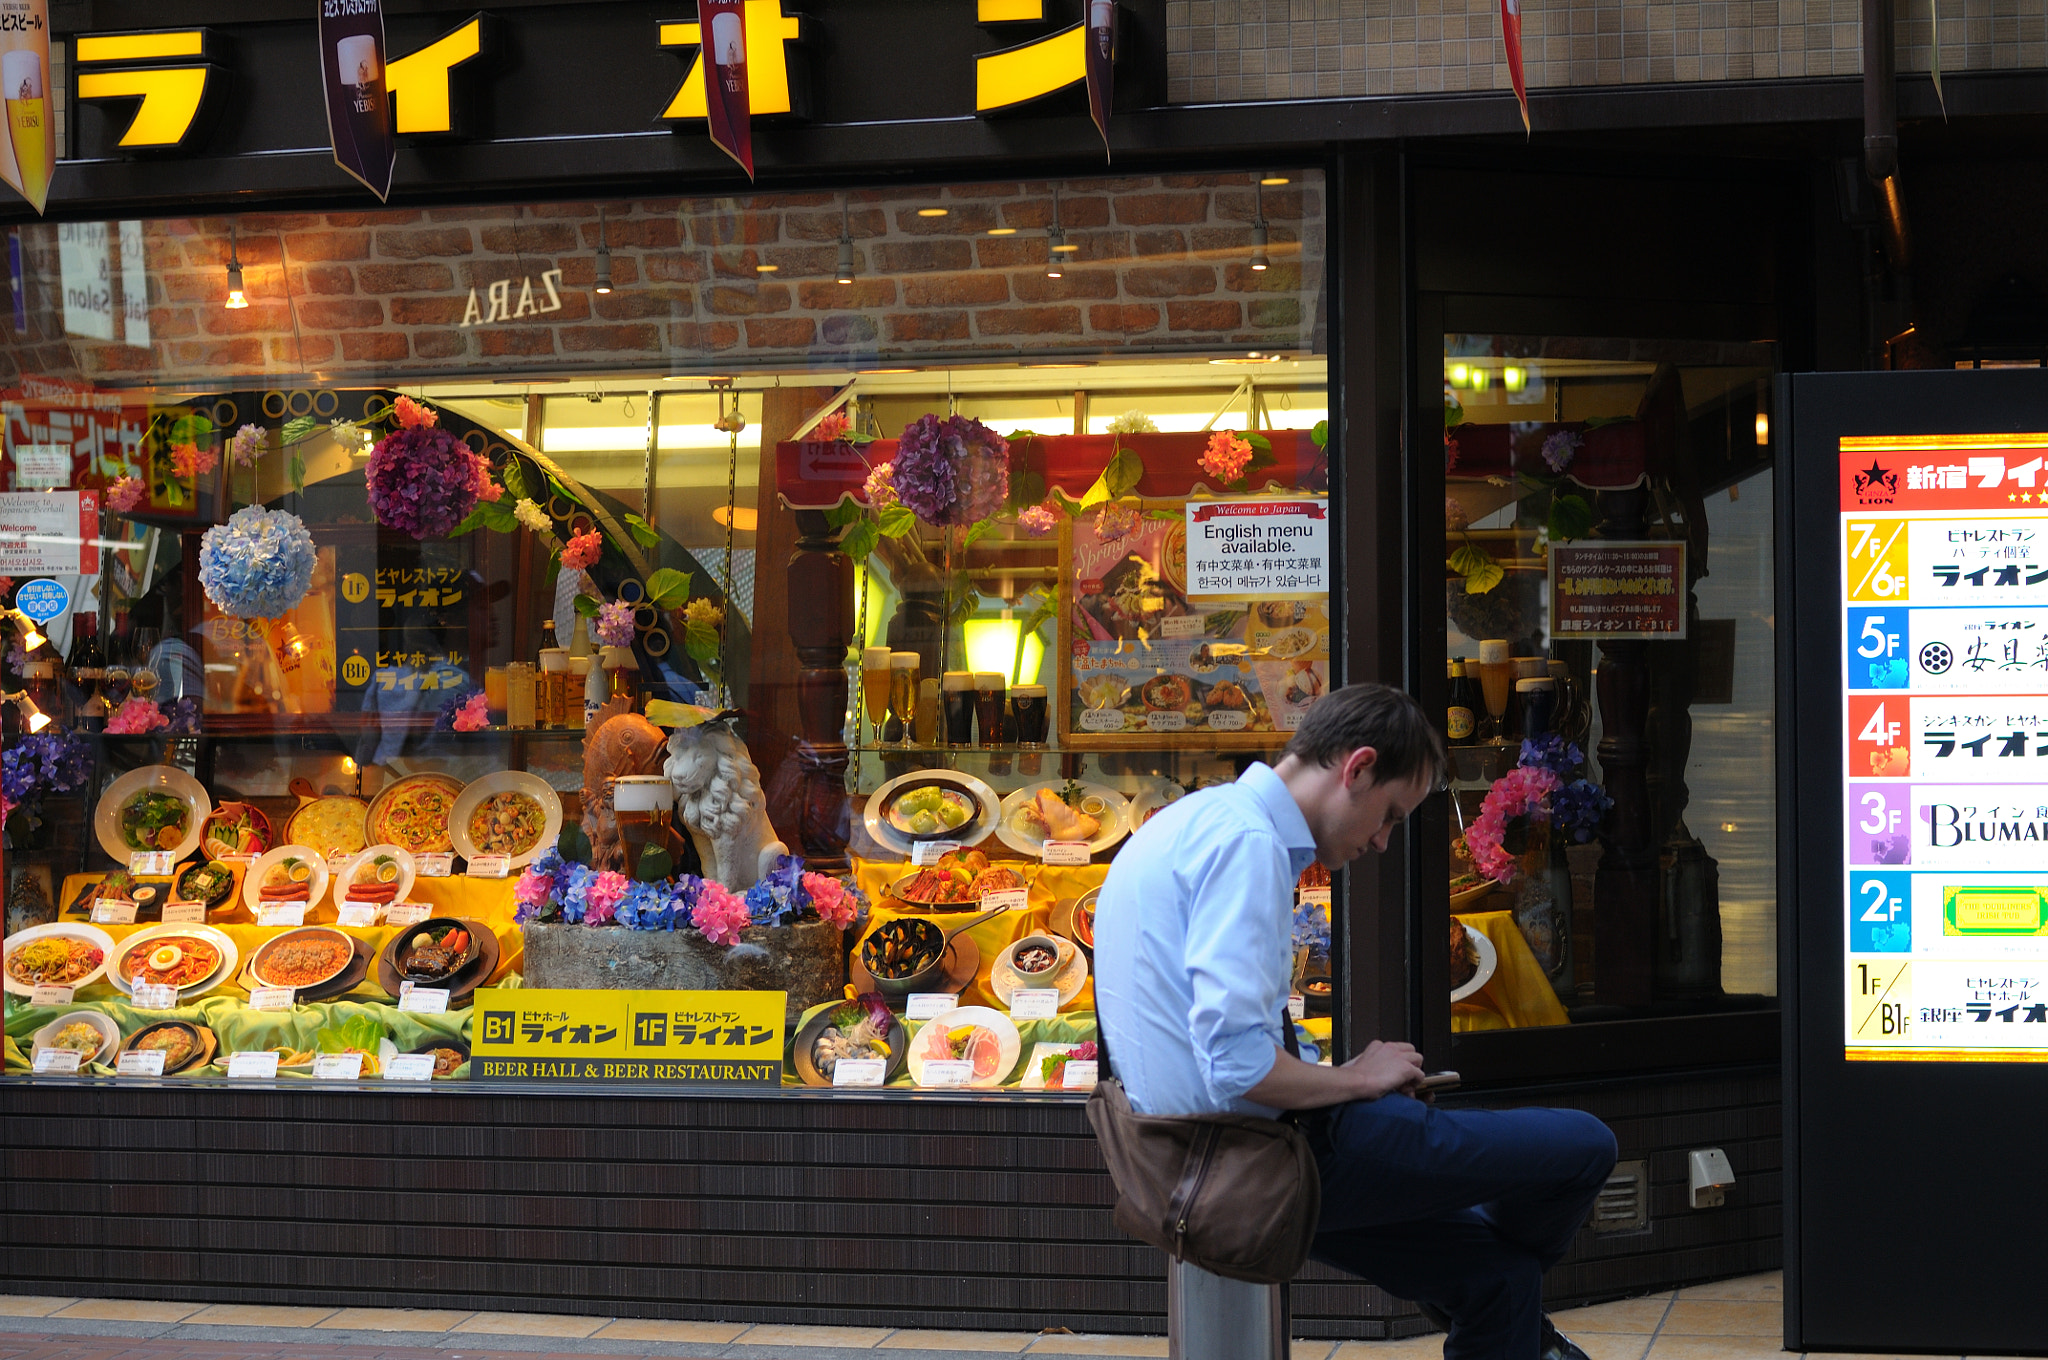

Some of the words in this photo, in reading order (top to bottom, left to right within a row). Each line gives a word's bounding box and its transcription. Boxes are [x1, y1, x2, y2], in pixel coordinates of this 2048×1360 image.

[0, 14, 42, 31] ビスビール
[1907, 456, 2048, 490] 新宿ライ
[1215, 504, 1256, 514] Welcome
[1259, 505, 1269, 513] to
[1271, 504, 1301, 515] Japan
[0, 524, 37, 532] Welcome
[1205, 524, 1262, 542] English
[1268, 525, 1313, 538] menu
[1221, 539, 1296, 553] available.
[375, 568, 462, 585] ビヤレストラン
[1198, 576, 1232, 589] 한국어
[1237, 575, 1271, 588] 메뉴가
[1275, 574, 1321, 587] 있습니다
[1933, 564, 2048, 587] ライオン
[375, 588, 462, 608] ライオン
[1857, 616, 1900, 658] 5F
[376, 651, 463, 668] ビヤホール
[376, 672, 463, 690] ライオン
[1857, 702, 1901, 746] 4F
[1860, 791, 1902, 834] 3F
[1860, 879, 1903, 921] 2F
[523, 1011, 570, 1022] ビヤホール
[674, 1011, 740, 1023] ビヤレストラン
[486, 1017, 511, 1040] B1
[521, 1023, 617, 1044] ライオン
[637, 1019, 664, 1042] 1F
[673, 1025, 774, 1046] ライオン
[483, 1061, 528, 1077] BEER
[532, 1062, 581, 1079] HALL
[585, 1063, 599, 1078] &
[603, 1064, 650, 1079] BEER
[653, 1064, 774, 1081] RESTAURANT
